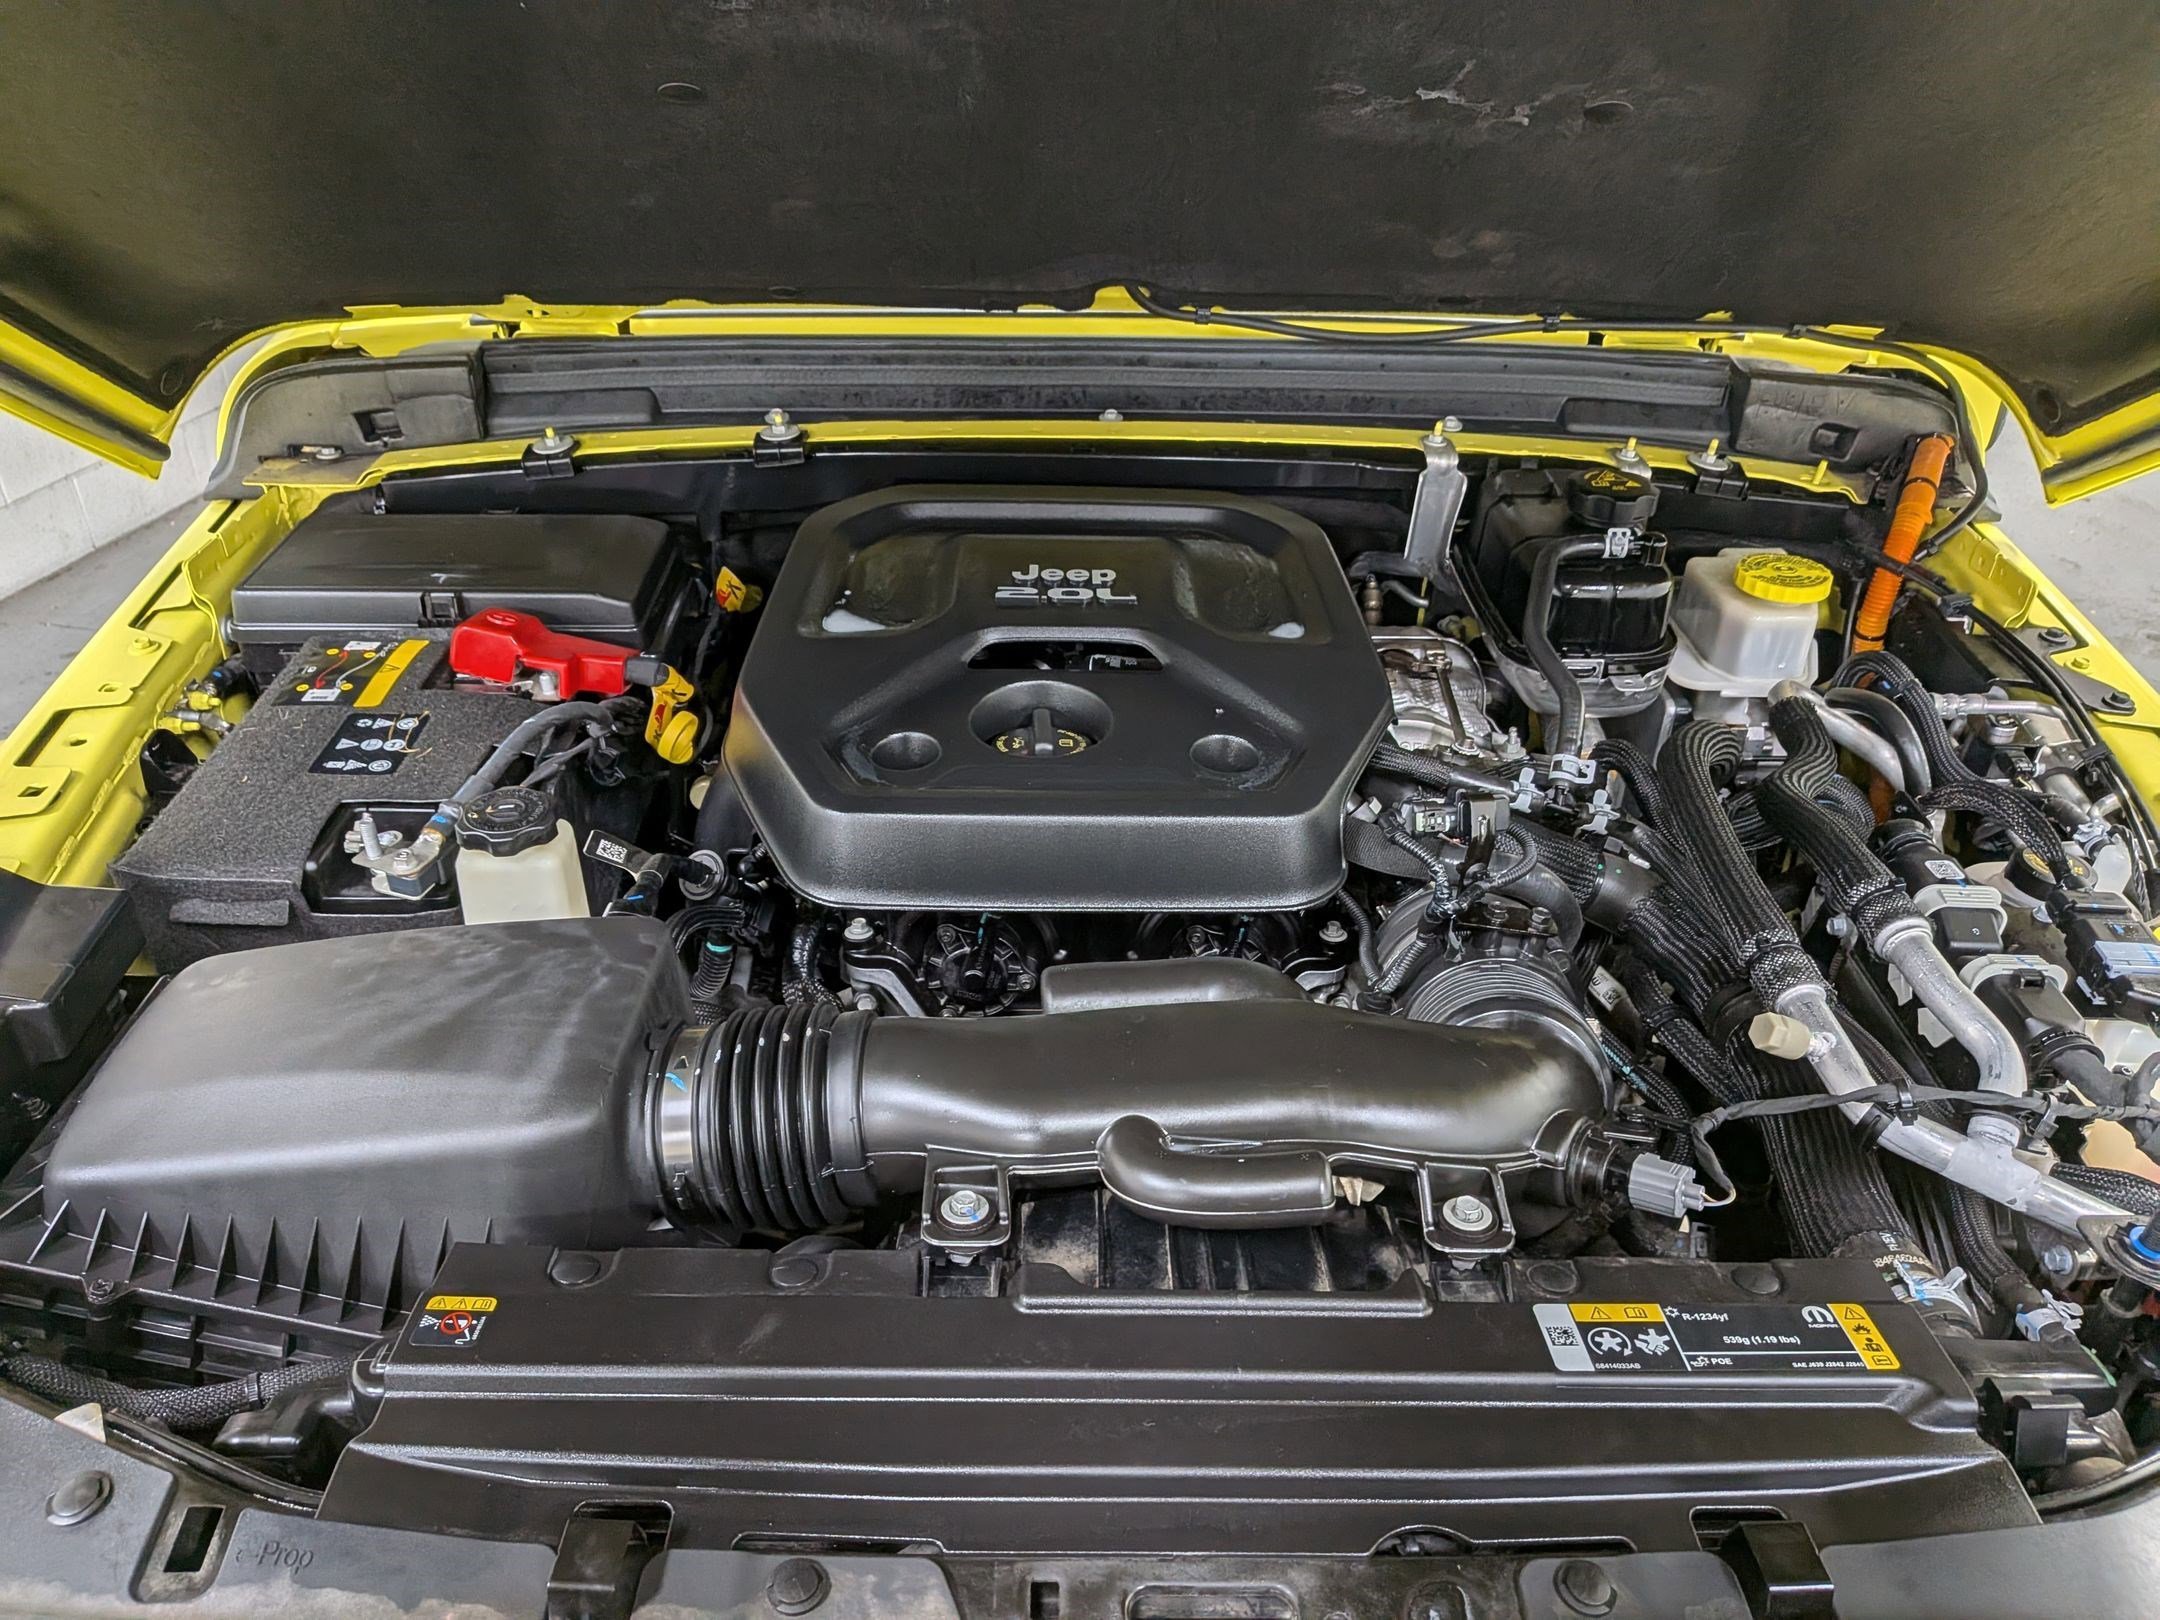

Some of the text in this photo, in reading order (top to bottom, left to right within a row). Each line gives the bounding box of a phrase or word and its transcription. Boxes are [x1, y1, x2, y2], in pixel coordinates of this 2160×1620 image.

[1012, 564, 1117, 585] Jeep
[995, 586, 1138, 604] 2.0L
[1681, 1312, 1729, 1322] R-1234yf
[1722, 1335, 1801, 1345] 539g (1.19 lbs)
[1711, 1357, 1734, 1366] POE
